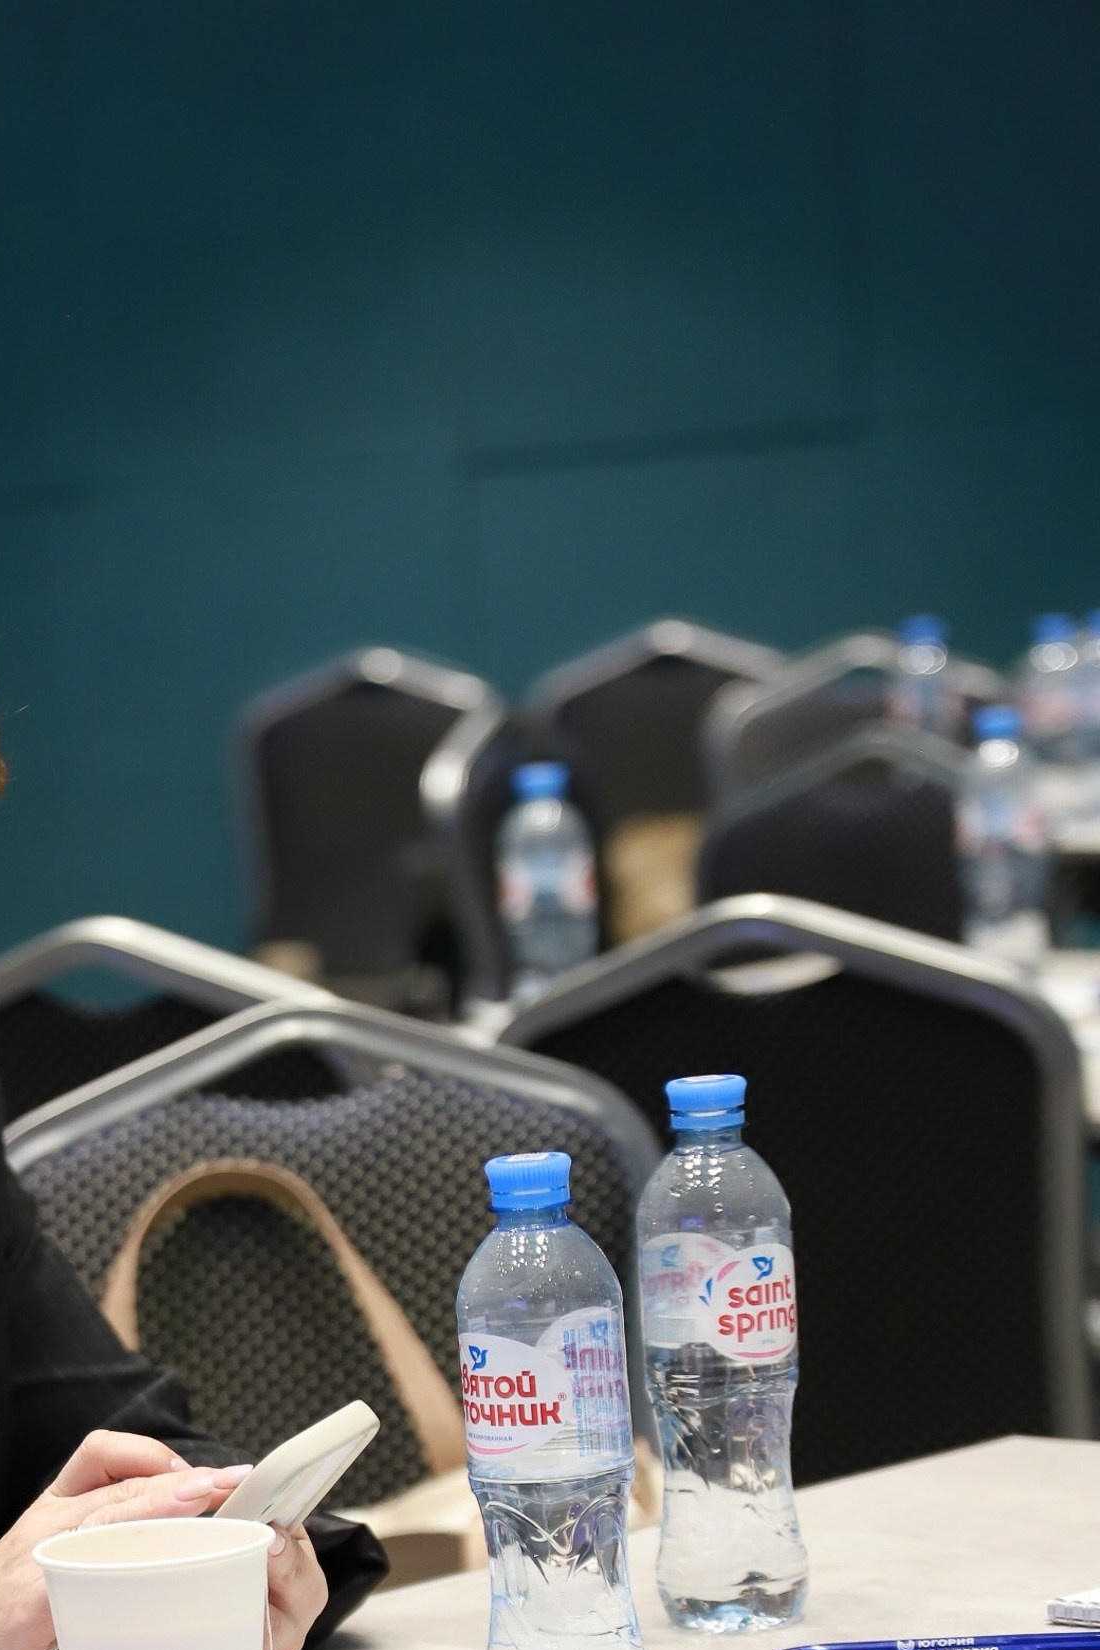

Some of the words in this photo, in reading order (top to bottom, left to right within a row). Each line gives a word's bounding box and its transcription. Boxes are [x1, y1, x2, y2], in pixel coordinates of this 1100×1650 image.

[728, 1274, 791, 1308] saint
[718, 1303, 797, 1343] spring
[918, 1637, 975, 1648] ЮГОРИЯ
